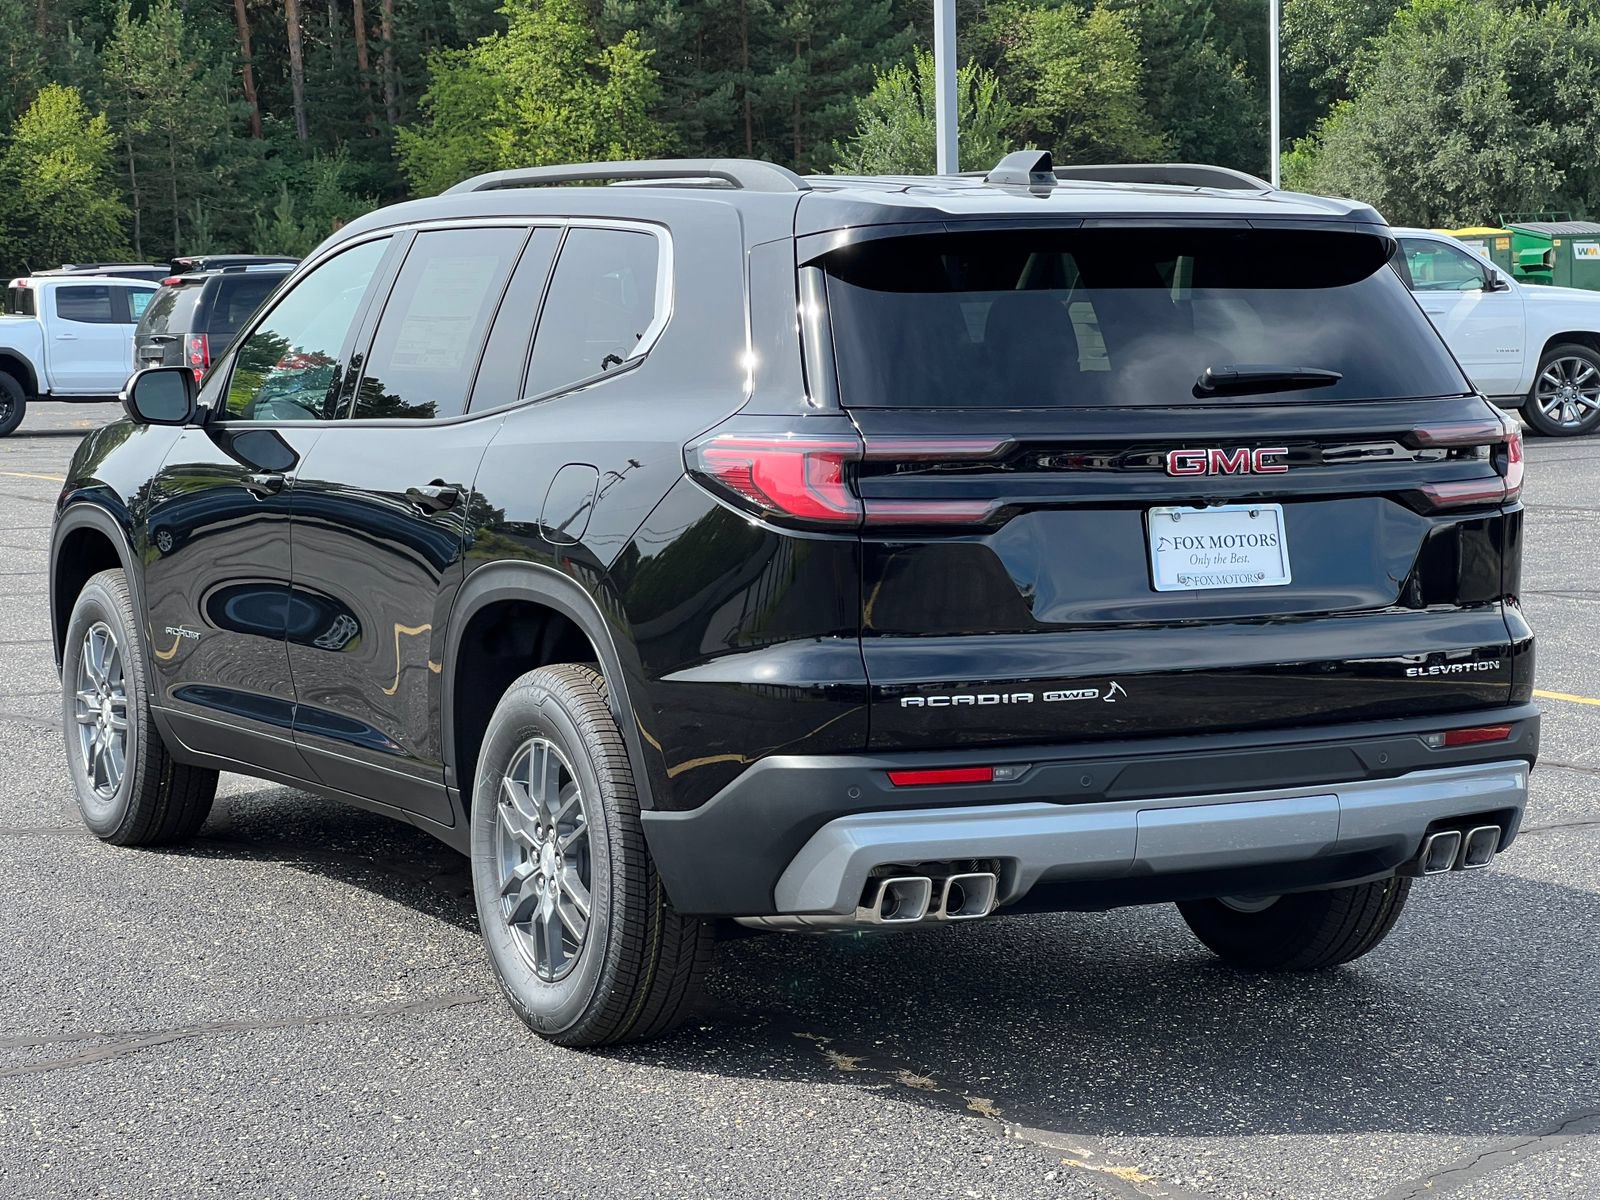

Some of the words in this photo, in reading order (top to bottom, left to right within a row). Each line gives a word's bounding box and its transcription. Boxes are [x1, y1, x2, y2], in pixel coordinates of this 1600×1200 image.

[1577, 247, 1598, 256] WM
[1166, 447, 1289, 476] GMC
[1173, 535, 1206, 550] FOX
[1209, 533, 1277, 549] MOTORS
[1189, 553, 1211, 568] Only
[1213, 552, 1227, 564] the
[1230, 552, 1250, 564] Best.
[1194, 575, 1214, 586] FOX
[1215, 573, 1259, 585] MOTORS
[1406, 660, 1500, 677] ELEVATION
[900, 692, 1034, 708] ACADIA
[1044, 689, 1098, 701] AWD
